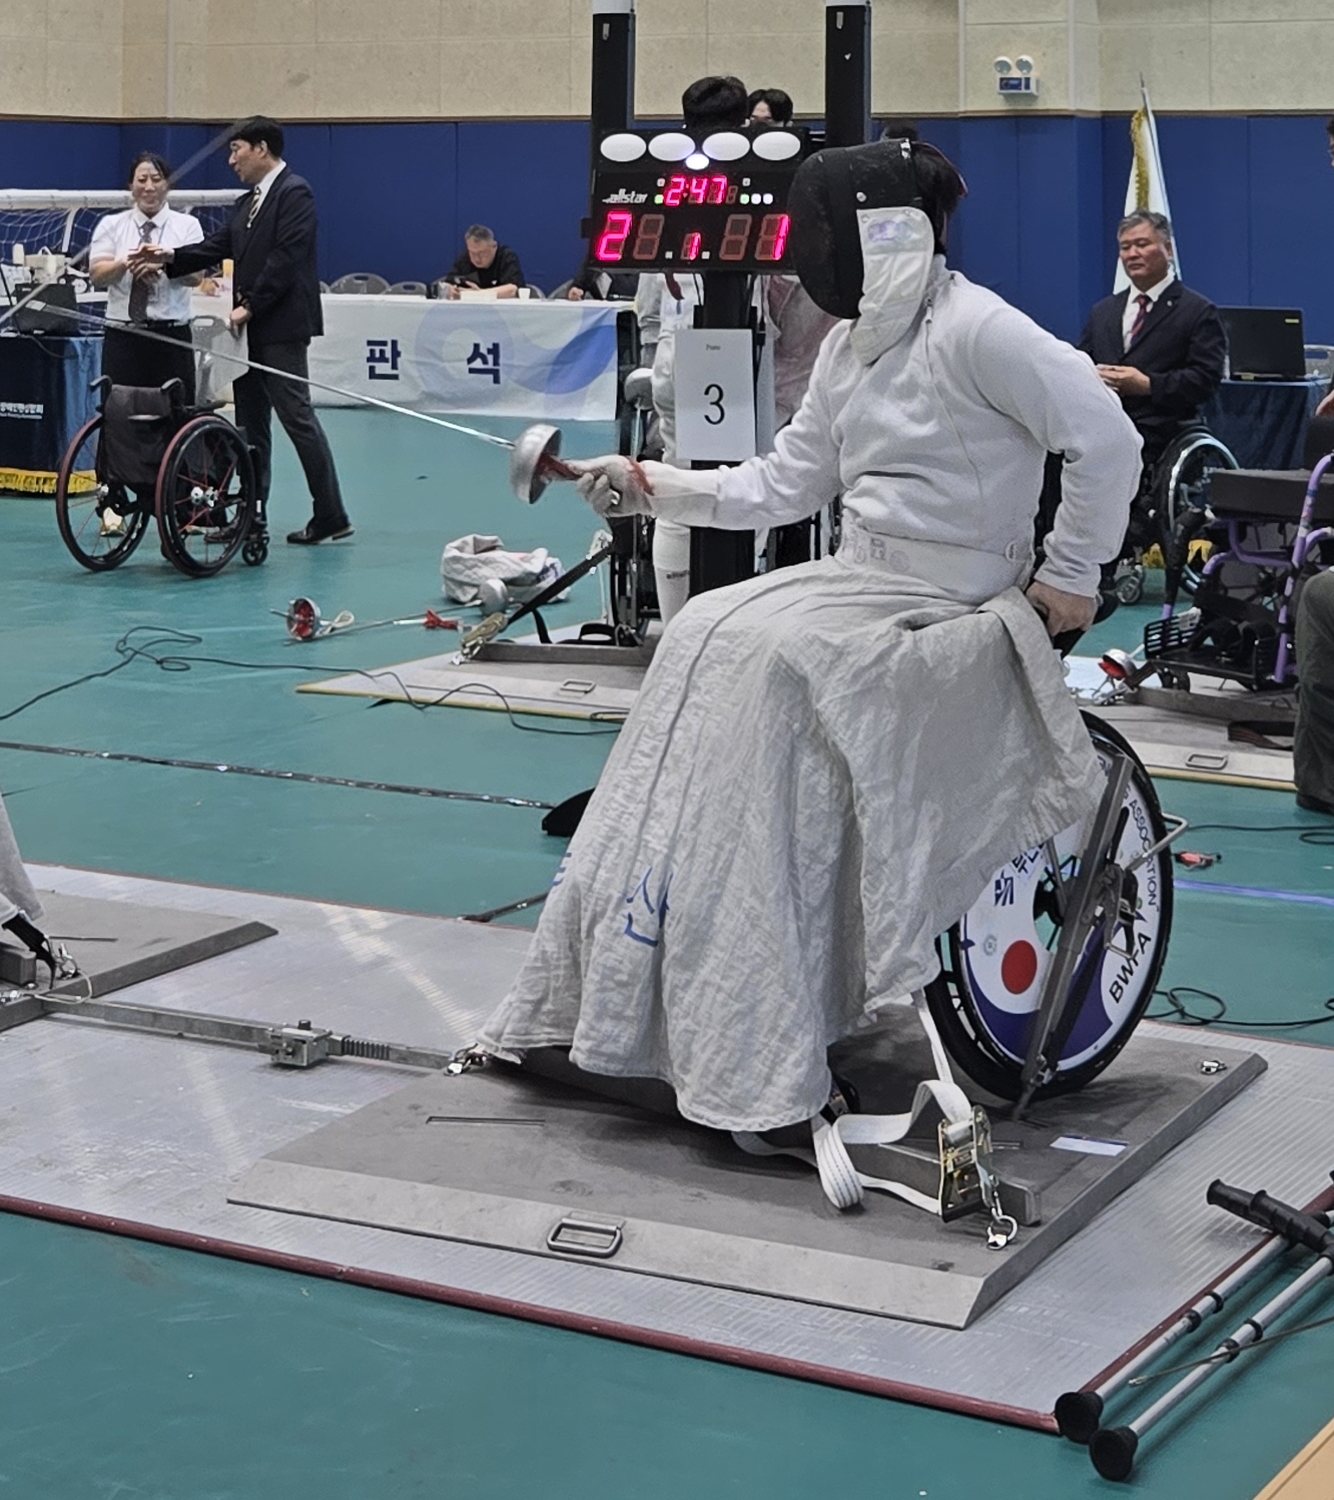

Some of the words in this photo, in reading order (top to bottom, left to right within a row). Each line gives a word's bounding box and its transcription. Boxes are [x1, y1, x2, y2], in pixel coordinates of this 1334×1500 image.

[604, 188, 649, 204] allstar
[664, 175, 728, 206] 2:47
[596, 210, 633, 262] 2
[772, 214, 791, 261] 1
[703, 383, 726, 426] 3
[1128, 798, 1158, 907] ASSOCATION
